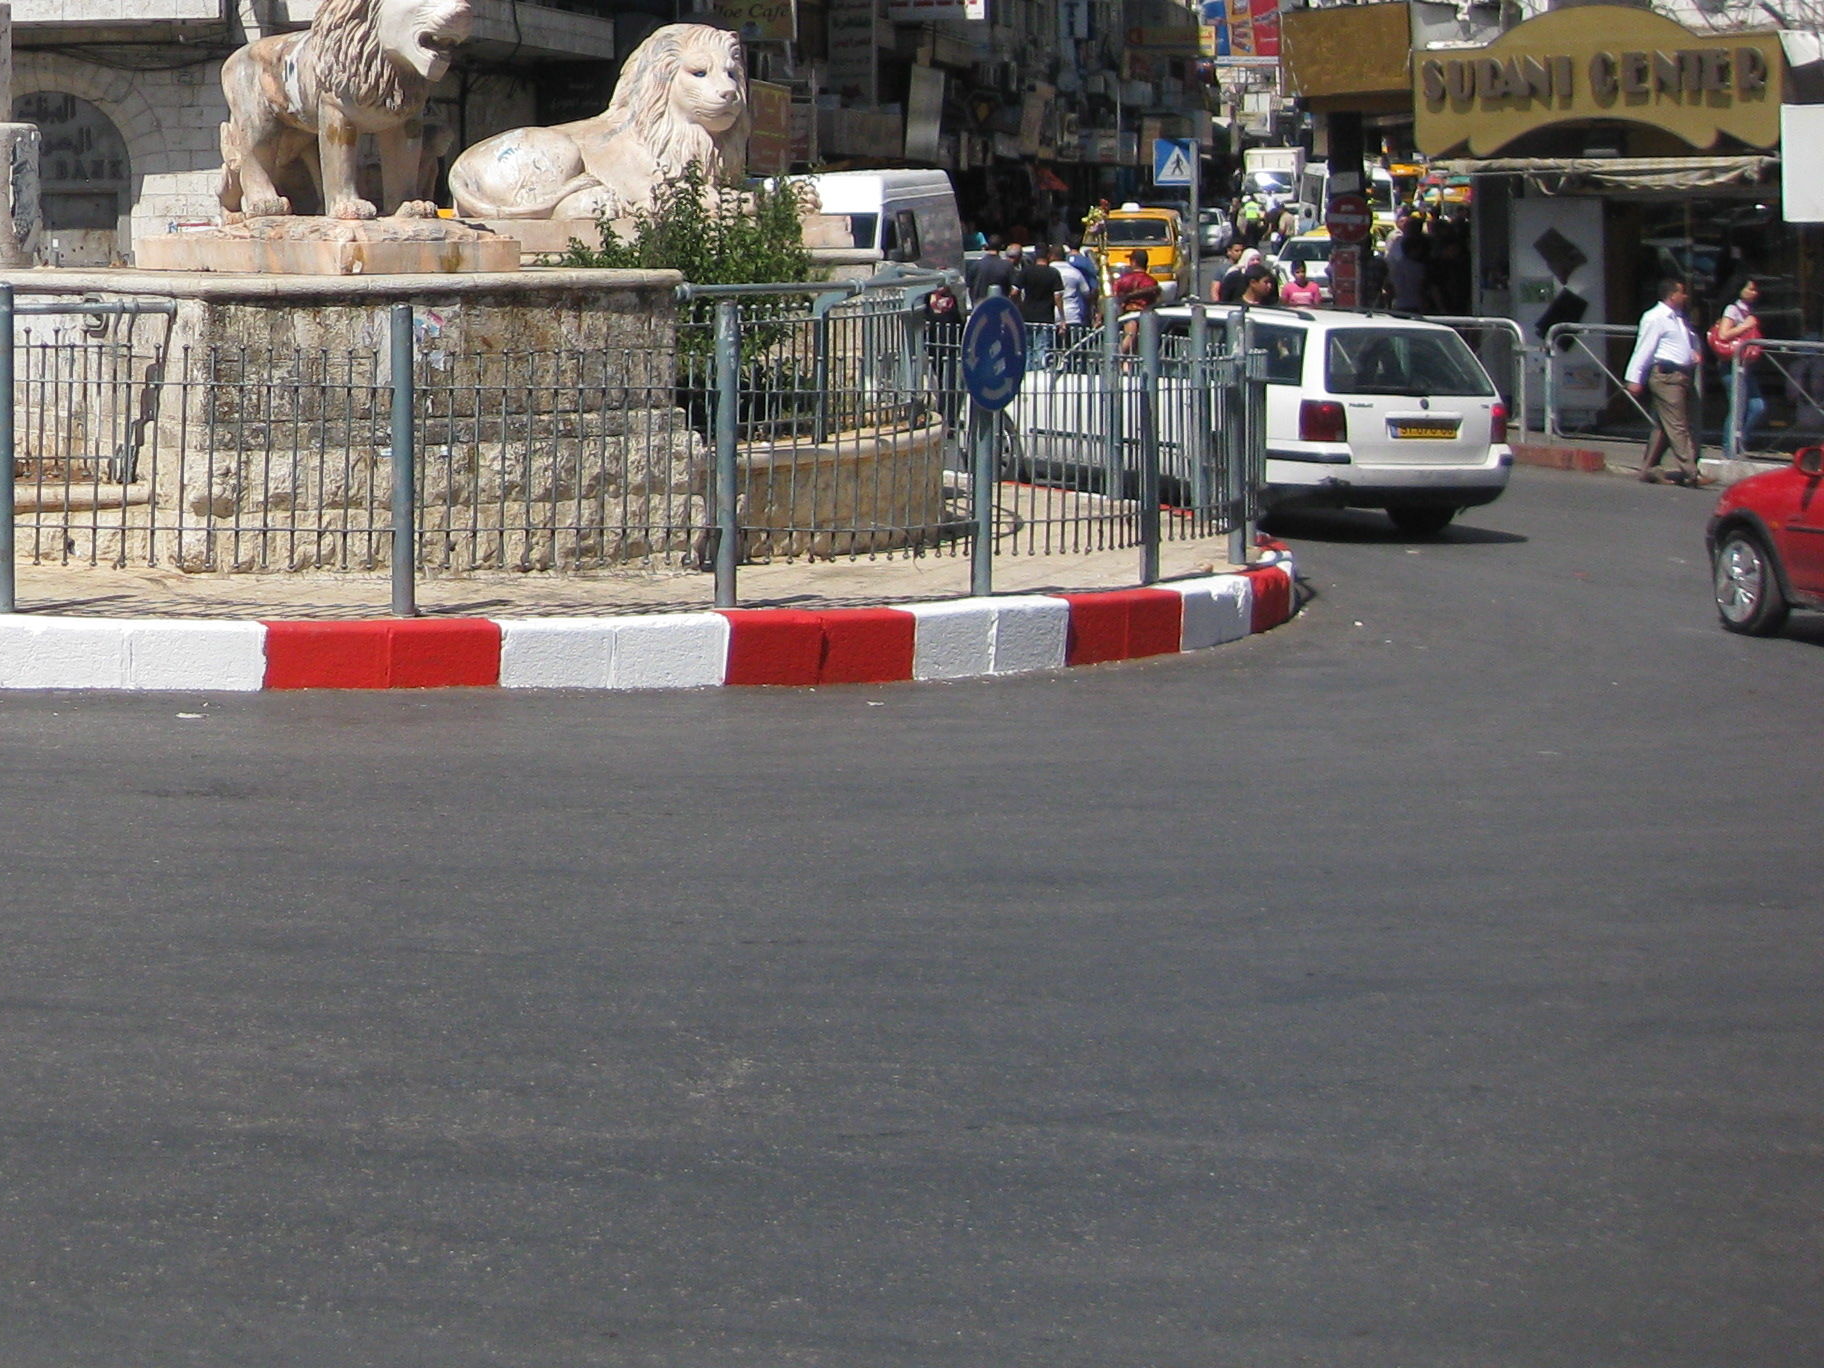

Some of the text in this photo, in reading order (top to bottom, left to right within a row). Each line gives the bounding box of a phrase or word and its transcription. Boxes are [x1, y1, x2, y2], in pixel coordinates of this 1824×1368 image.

[1422, 46, 1768, 110] SUDANI CENTER
[16, 94, 77, 124] البنك
[56, 159, 124, 180] BANK
